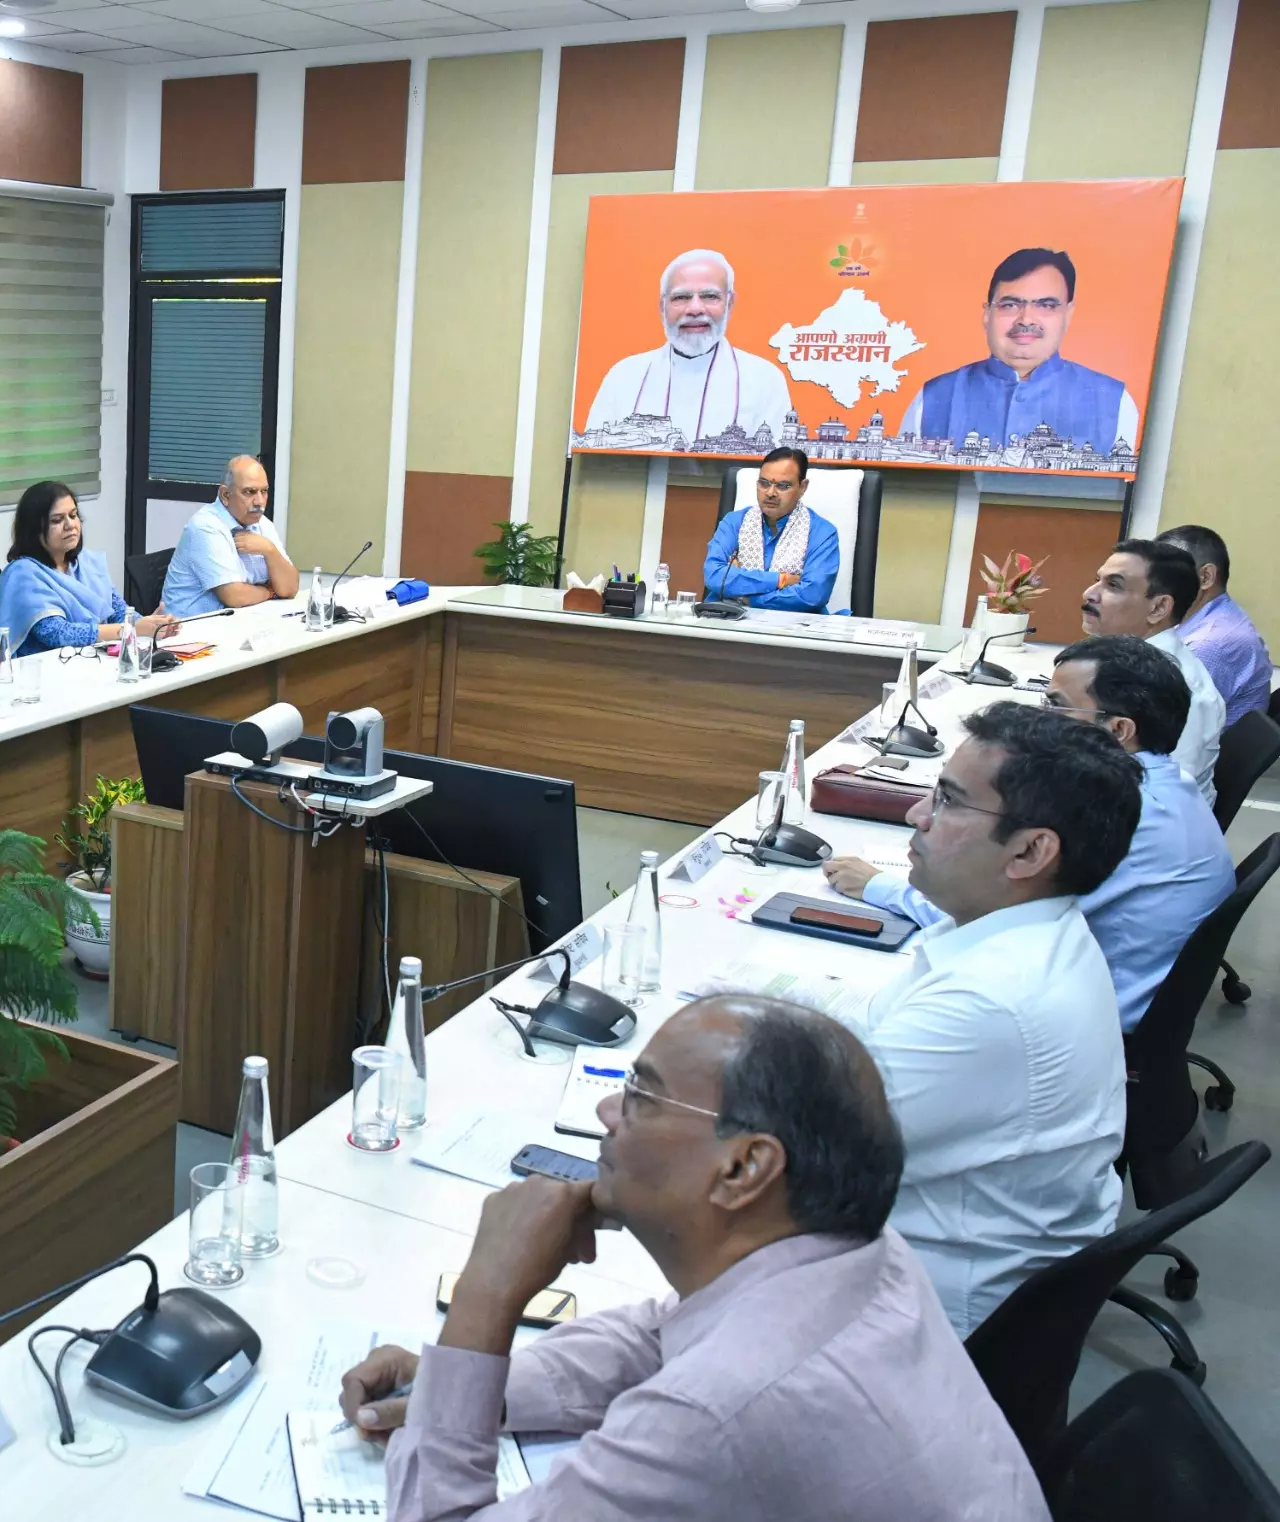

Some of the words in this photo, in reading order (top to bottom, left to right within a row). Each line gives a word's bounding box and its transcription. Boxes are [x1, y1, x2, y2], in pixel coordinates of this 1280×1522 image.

[794, 329, 838, 344] आपणो
[843, 330, 887, 344] अग्रणी
[788, 344, 891, 362] राजस्थान
